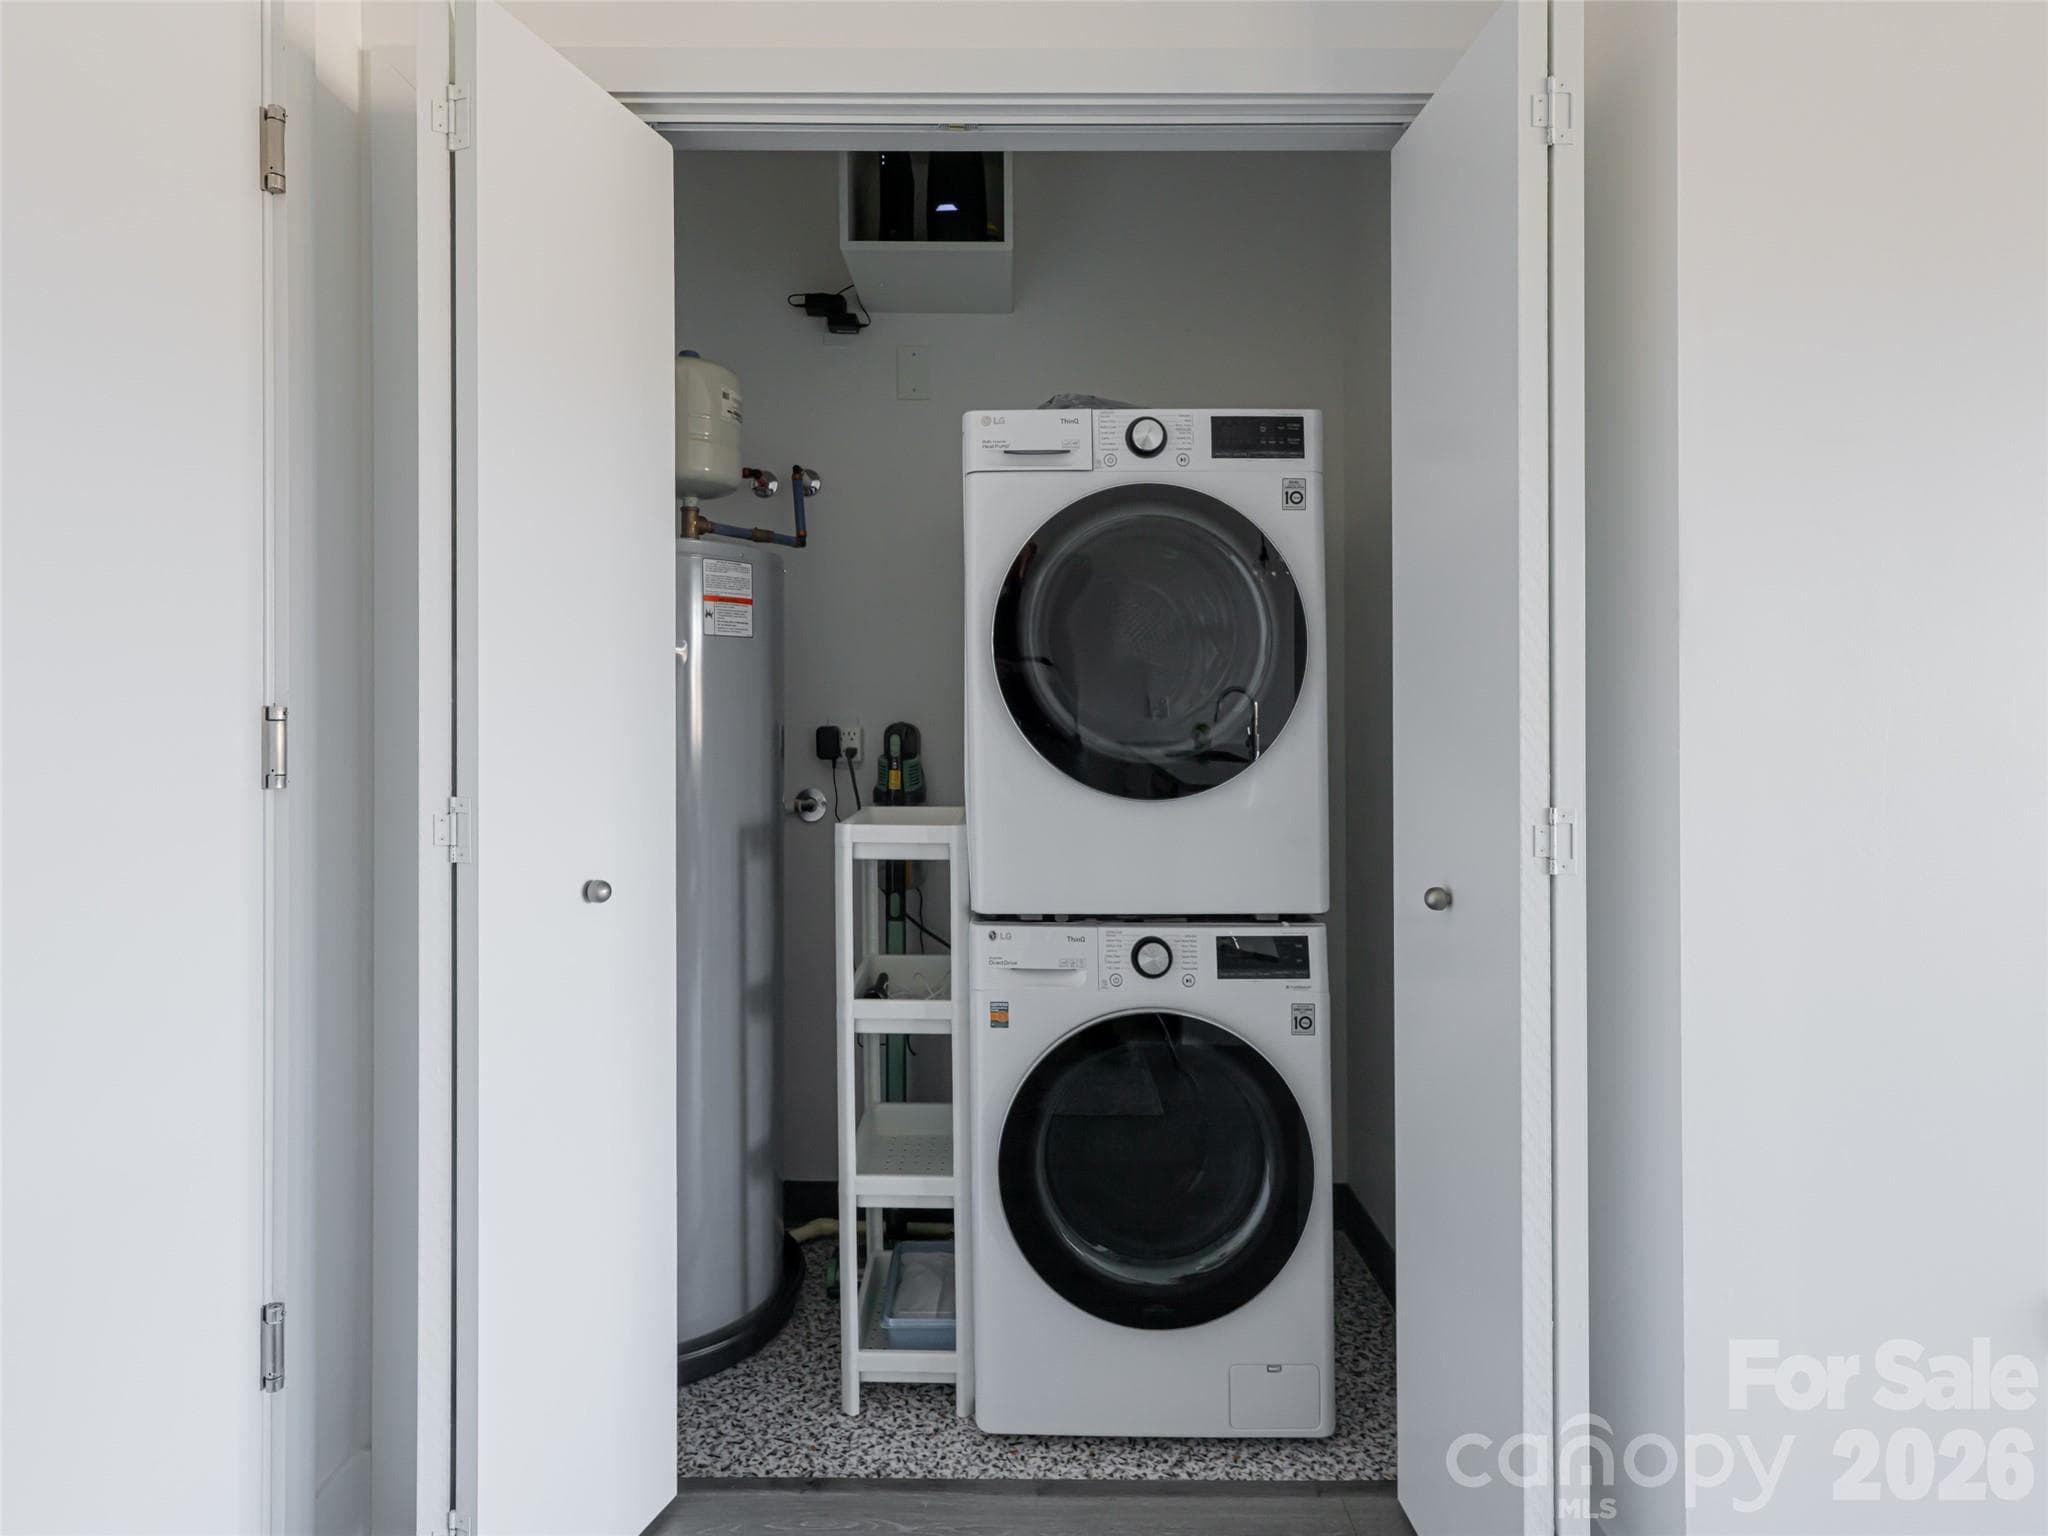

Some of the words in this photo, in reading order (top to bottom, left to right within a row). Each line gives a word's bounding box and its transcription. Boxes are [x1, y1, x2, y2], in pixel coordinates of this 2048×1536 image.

[993, 416, 1006, 425] LG
[1285, 491, 1303, 504] 10
[999, 932, 1012, 940] LG
[1294, 1016, 1312, 1030] 10
